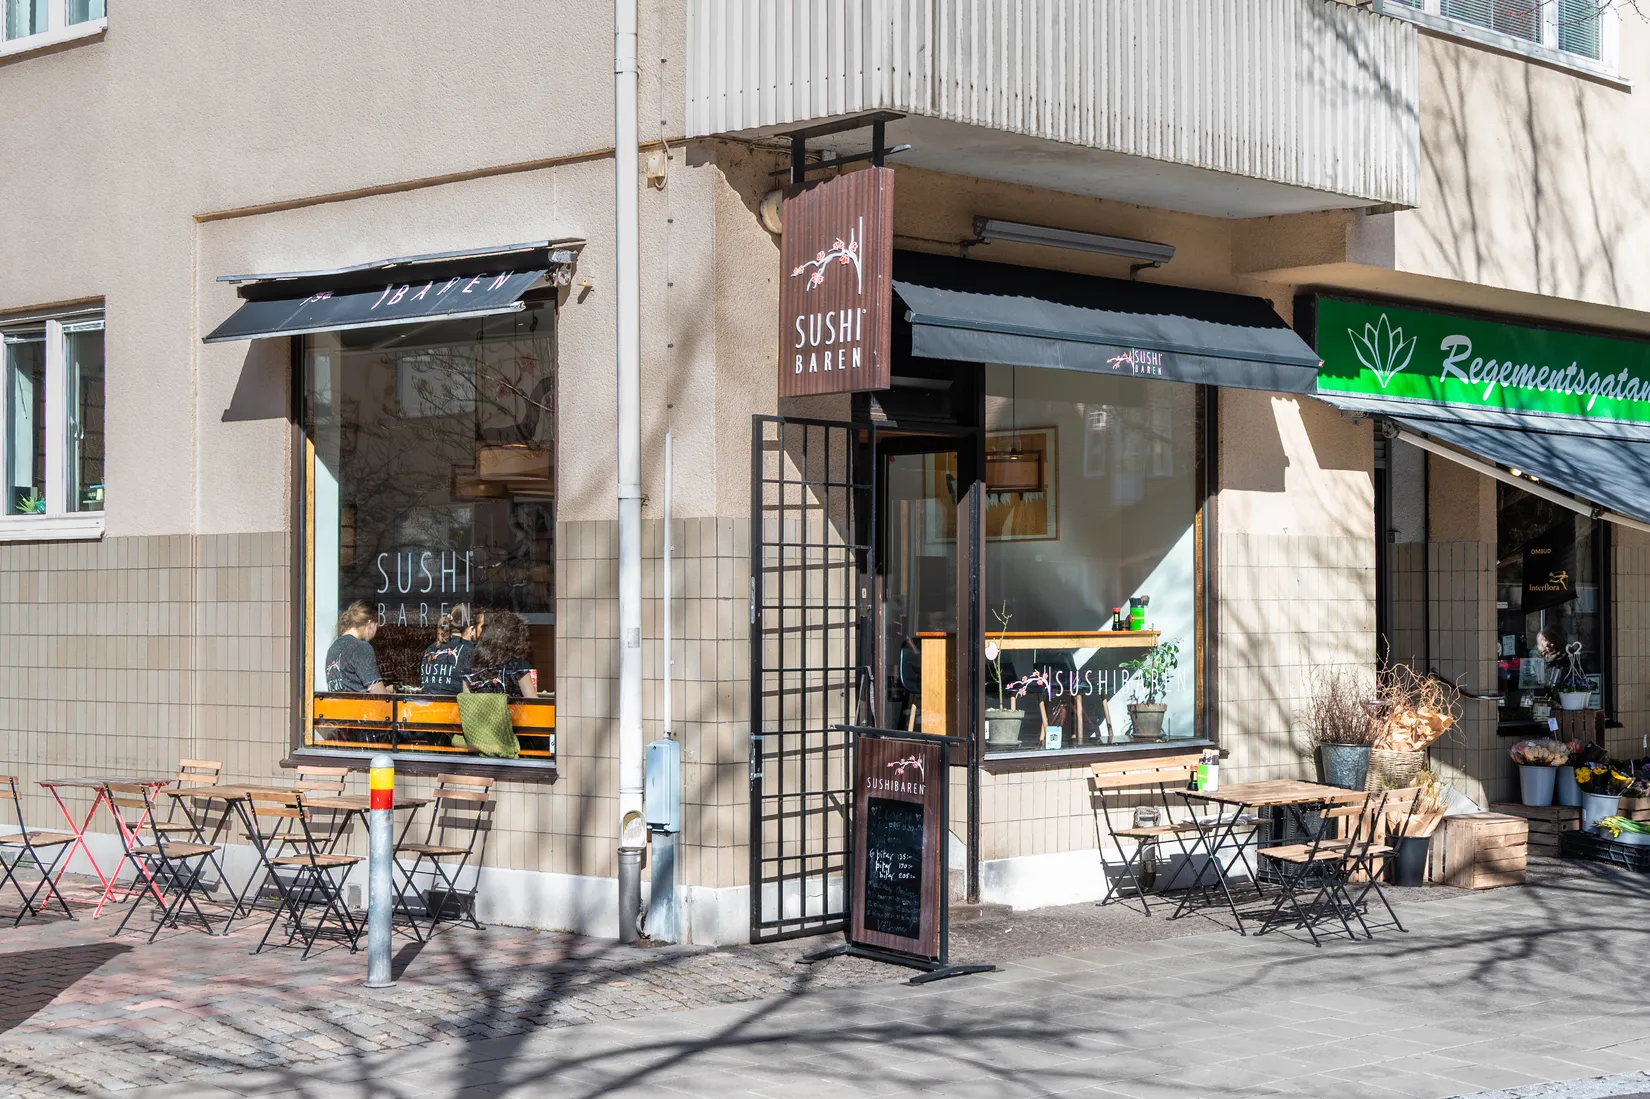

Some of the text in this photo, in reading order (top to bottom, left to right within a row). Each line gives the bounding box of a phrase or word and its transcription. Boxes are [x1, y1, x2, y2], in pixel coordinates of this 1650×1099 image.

[795, 307, 861, 349] SUSHI
[795, 347, 861, 374] BAREN
[1134, 350, 1162, 366] SUSHI
[1134, 365, 1162, 376] BAREN
[376, 550, 471, 594] SUSHI
[1529, 582, 1560, 592] Interflora
[376, 602, 471, 628] BAREN
[420, 663, 453, 677] SUSHI
[1055, 667, 1187, 698] SUSHIBAREN
[866, 776, 925, 796] SUSHIBAREN
